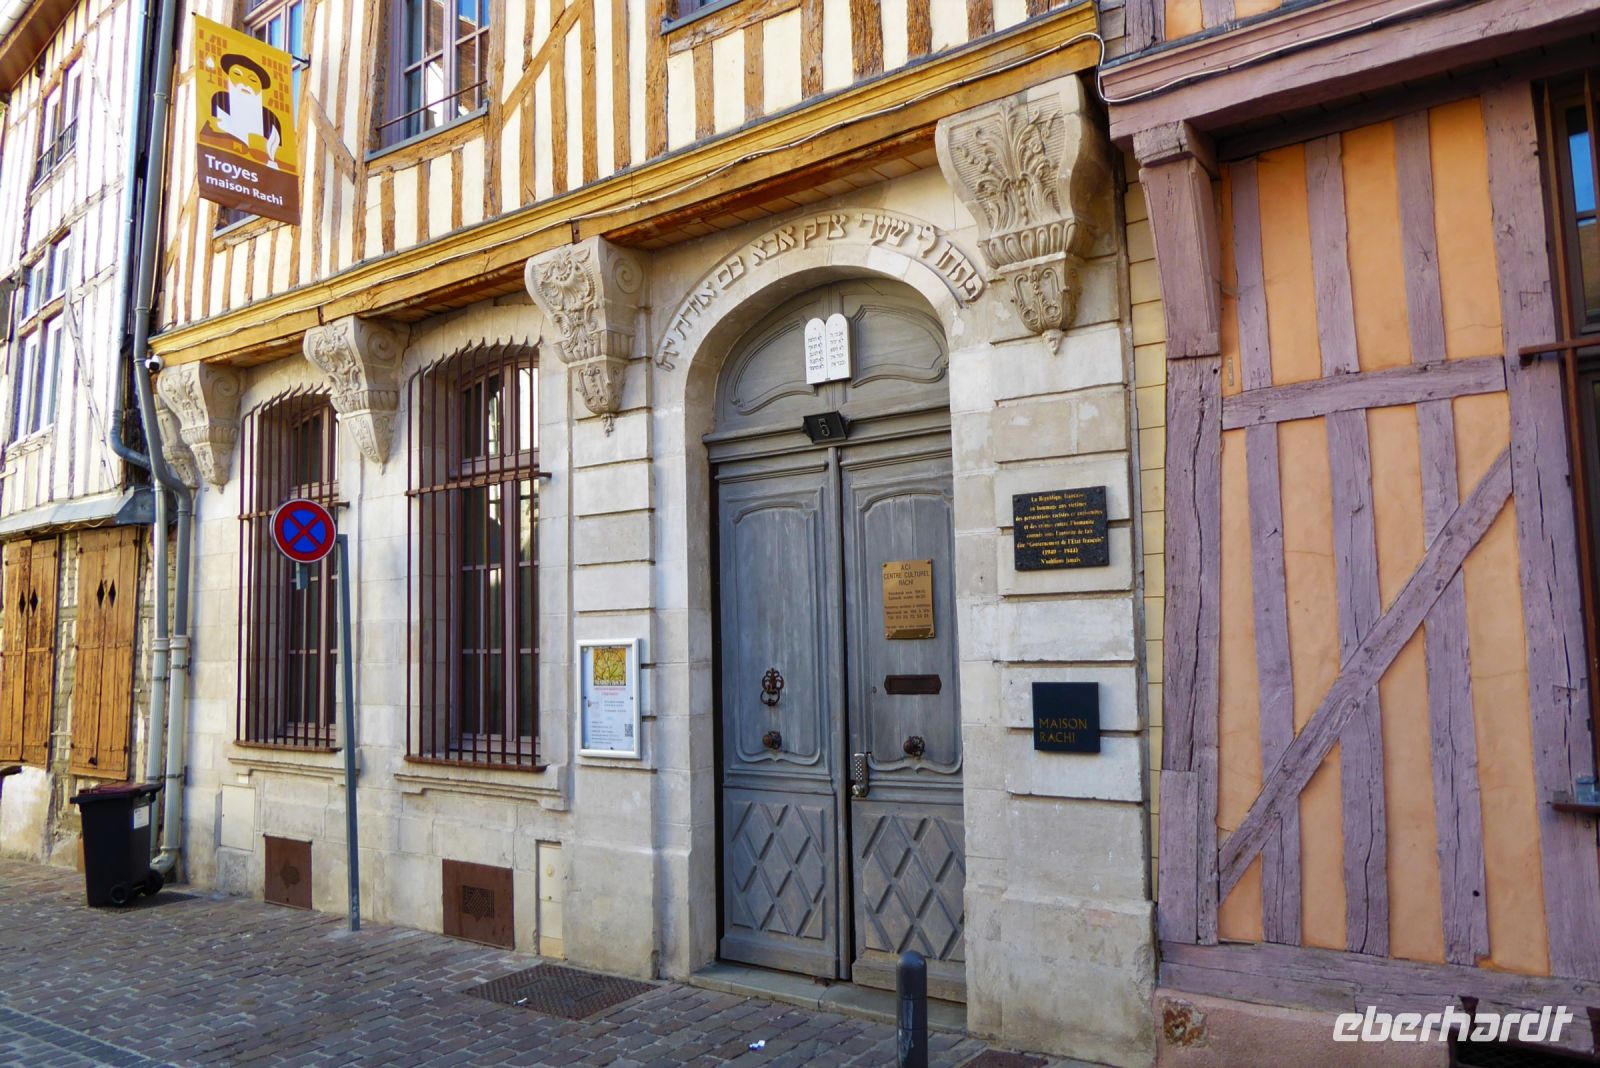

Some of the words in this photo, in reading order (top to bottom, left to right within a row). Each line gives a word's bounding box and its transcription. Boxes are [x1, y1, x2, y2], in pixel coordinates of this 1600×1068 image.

[204, 154, 259, 182] Troyes
[205, 175, 250, 195] maison
[252, 187, 283, 206] Rachi
[750, 225, 798, 267] אבא
[802, 214, 848, 250] צדק
[859, 212, 913, 248] שערי
[915, 224, 939, 259] לי
[935, 240, 986, 303] פתחו
[818, 418, 831, 437] 5
[1039, 718, 1087, 729] MAISON
[1040, 731, 1076, 743] RACHI
